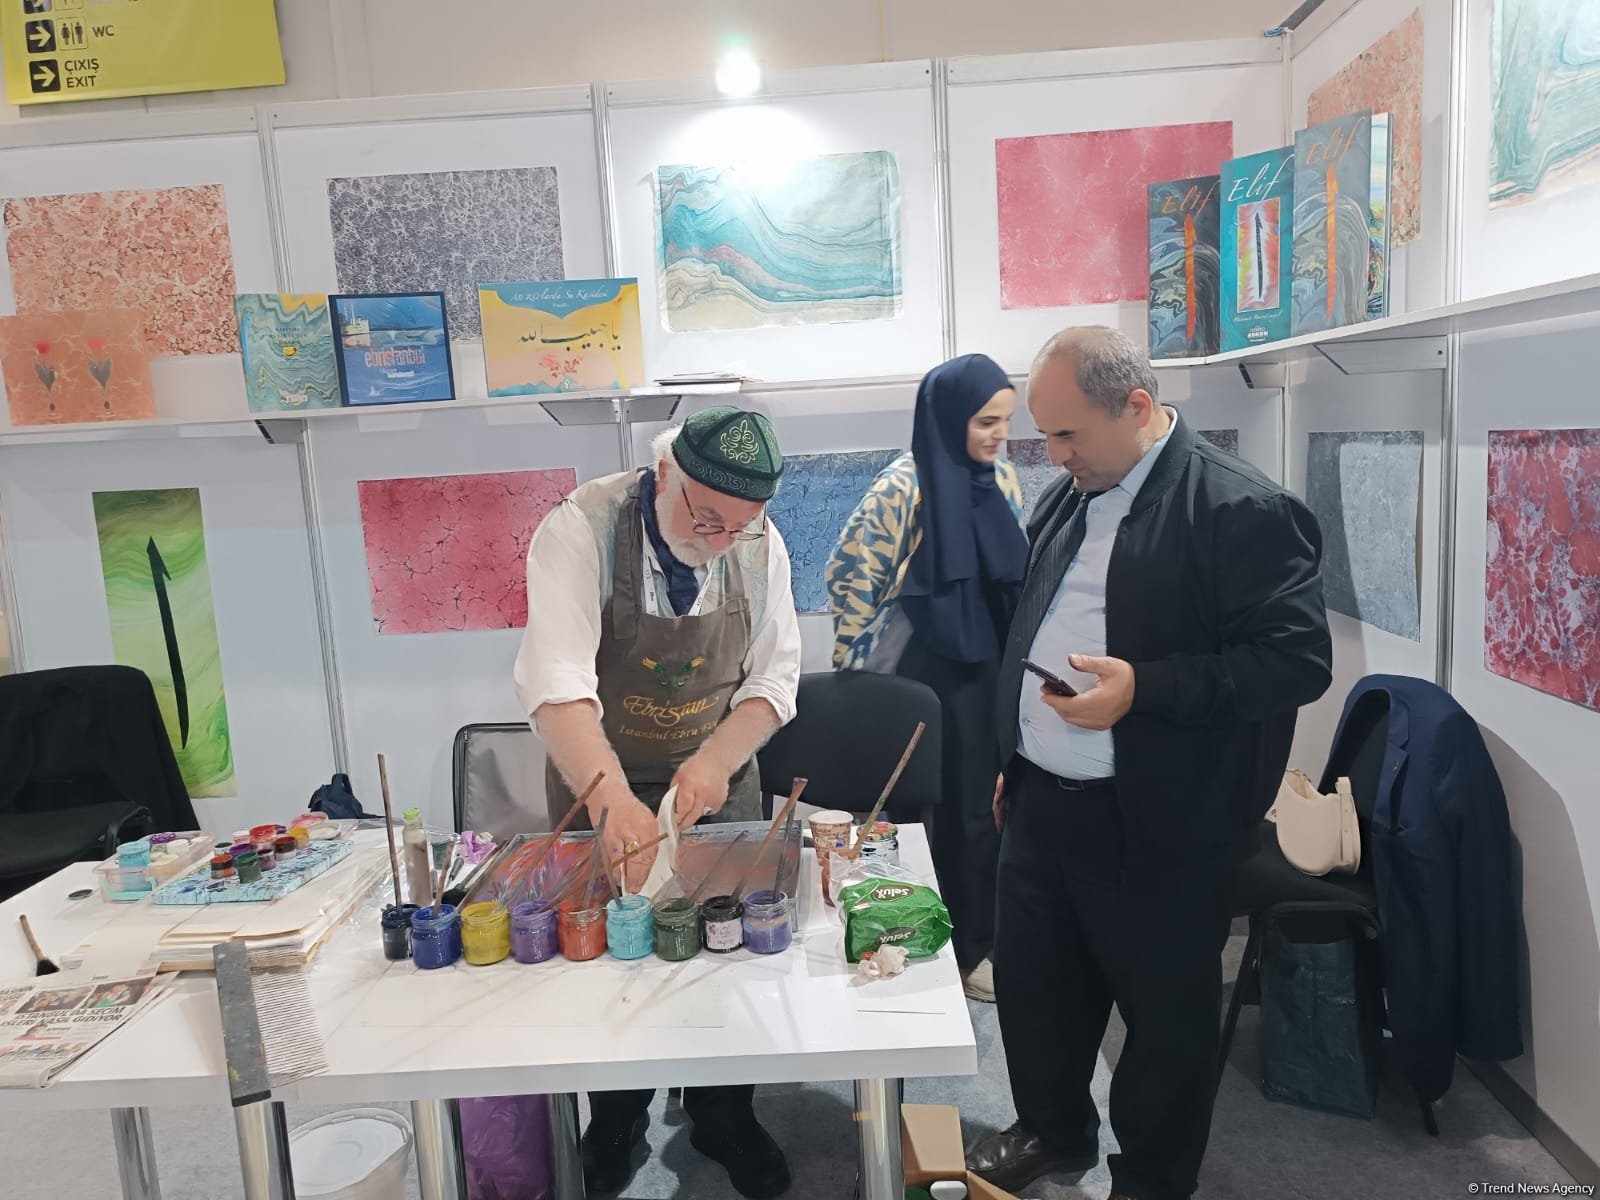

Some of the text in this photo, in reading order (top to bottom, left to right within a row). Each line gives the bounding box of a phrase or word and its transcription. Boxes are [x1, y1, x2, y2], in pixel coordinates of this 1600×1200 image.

[91, 24, 115, 37] WC
[64, 58, 100, 75] ÇIXIŞ
[66, 75, 97, 89] EXIT
[1228, 153, 1296, 202] Elif
[1161, 179, 1221, 222] Elif
